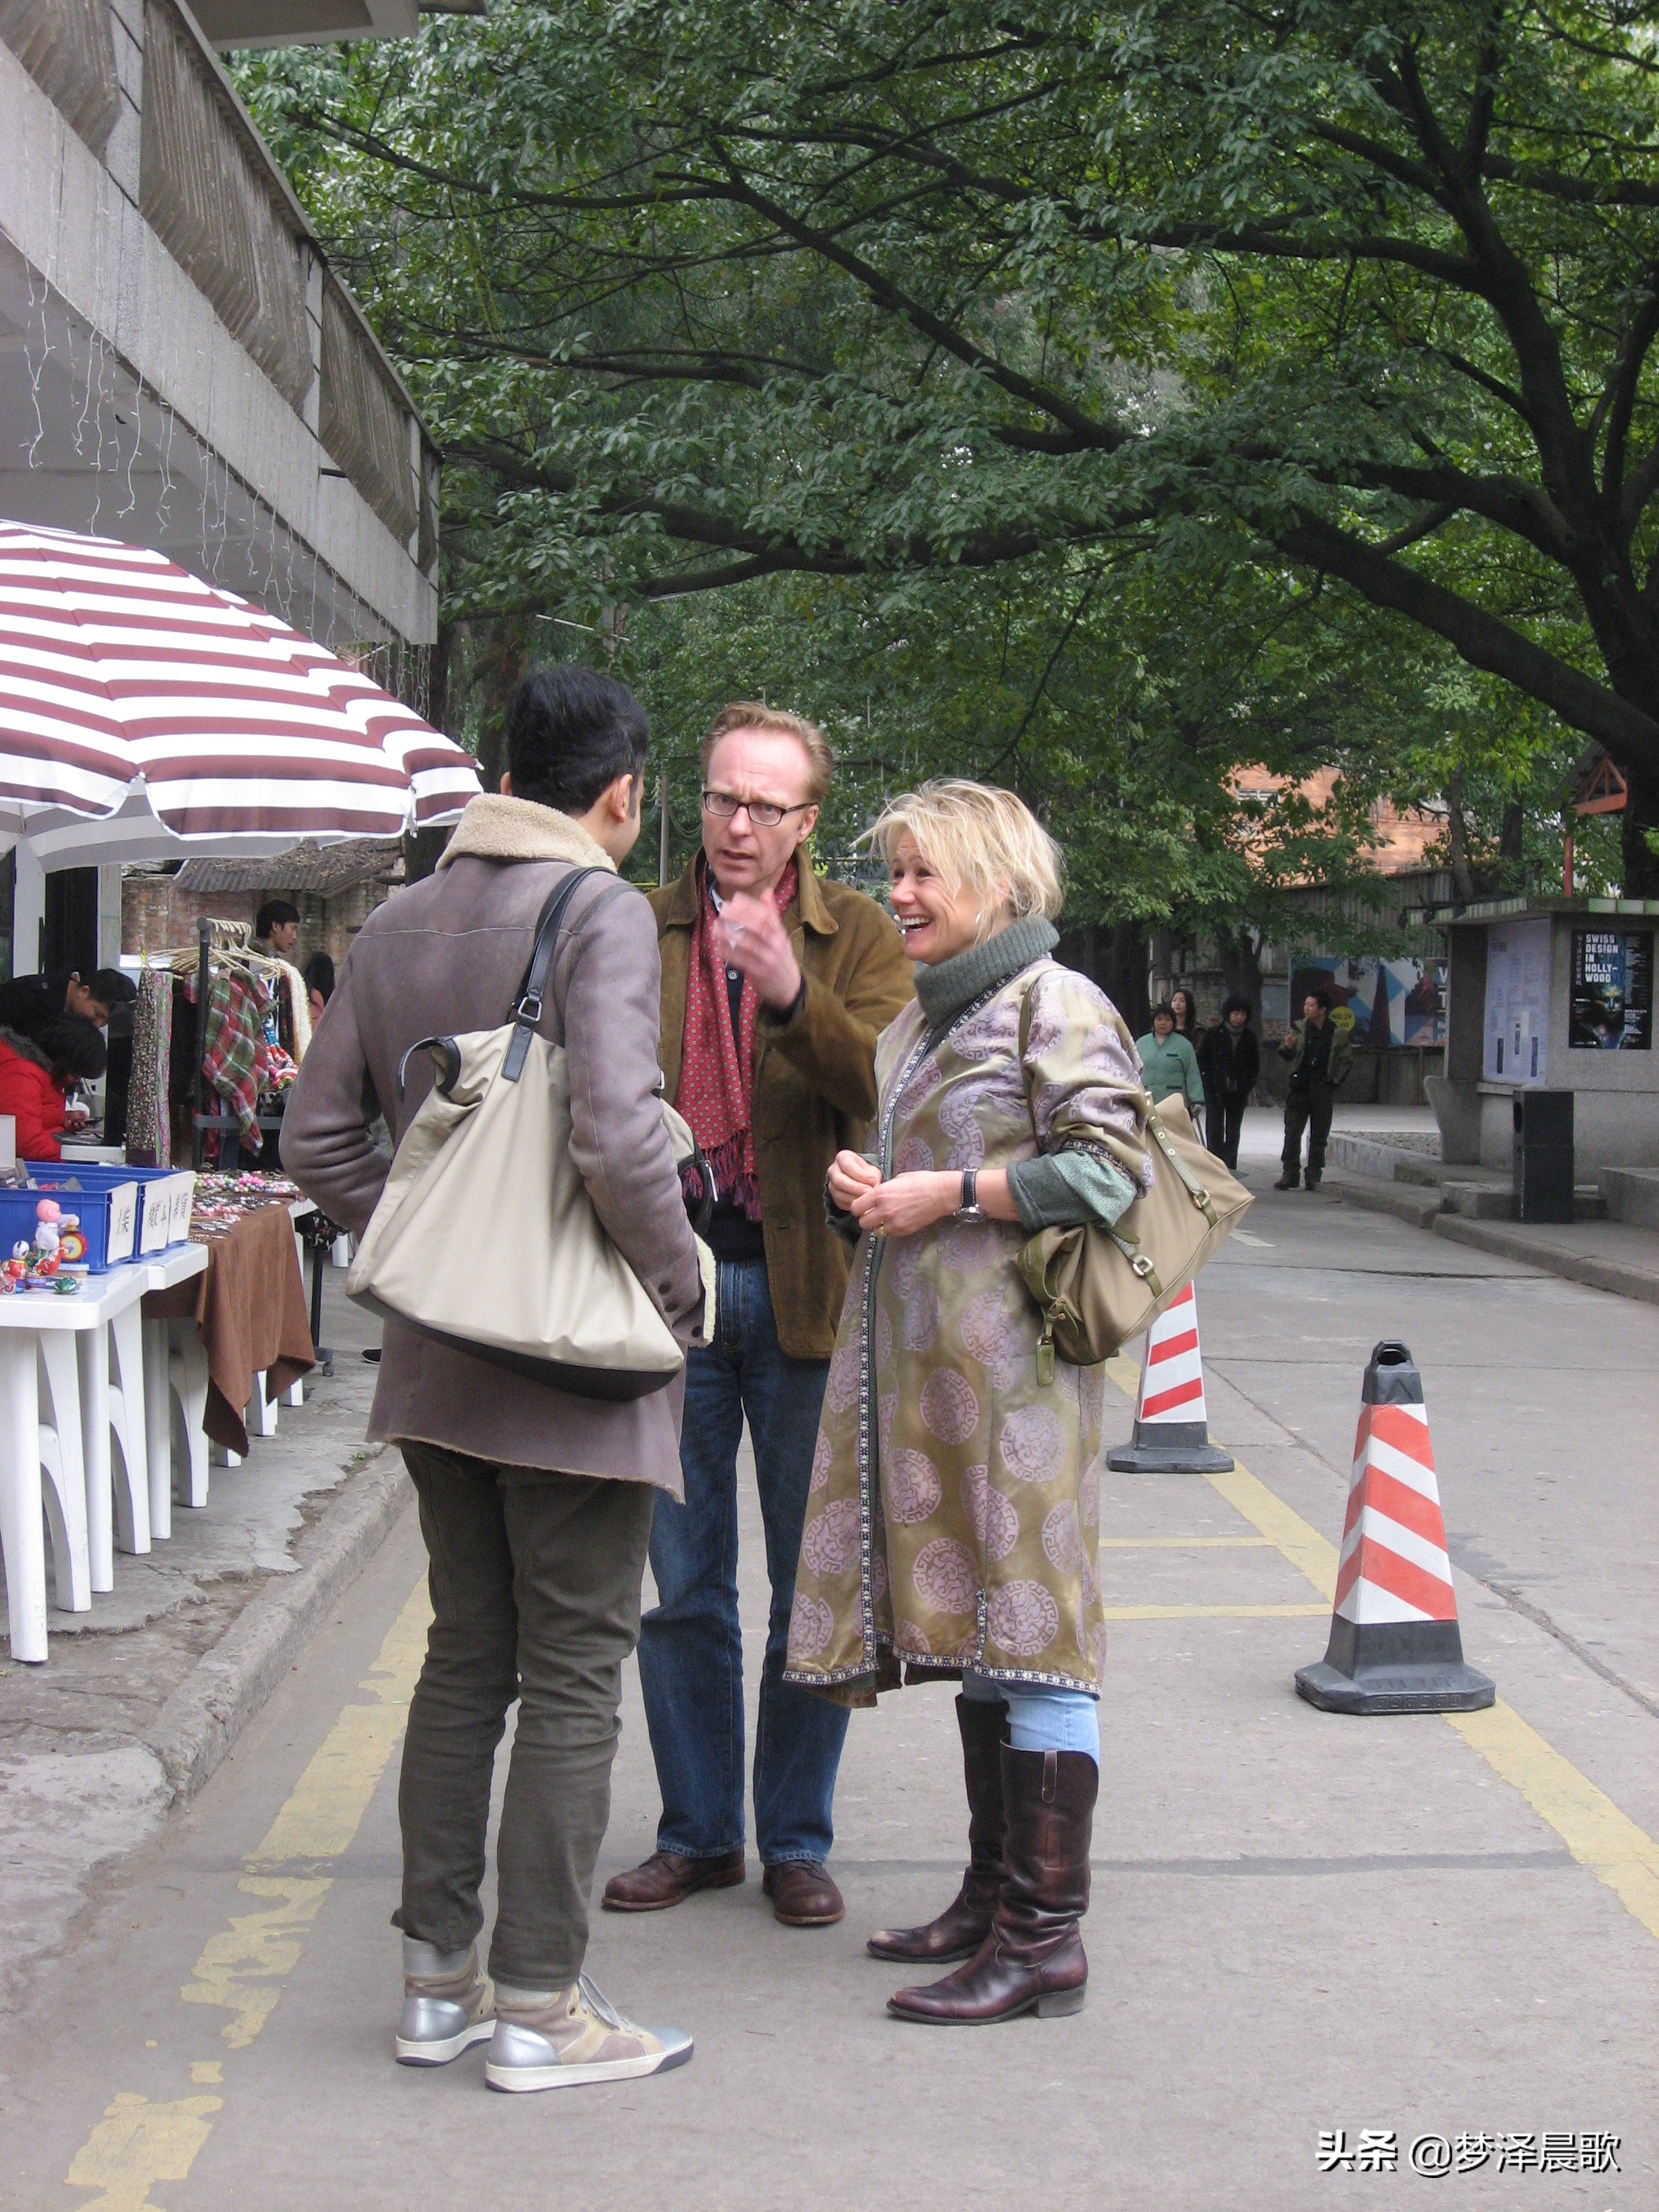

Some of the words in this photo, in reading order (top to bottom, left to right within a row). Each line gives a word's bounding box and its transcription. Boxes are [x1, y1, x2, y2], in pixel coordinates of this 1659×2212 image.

[1586, 933, 1616, 943] SWISS
[1585, 943, 1619, 954] DESIGN
[1585, 953, 1595, 963] IN
[1585, 963, 1619, 972] HOLLY-
[1585, 973, 1612, 983] WOOD
